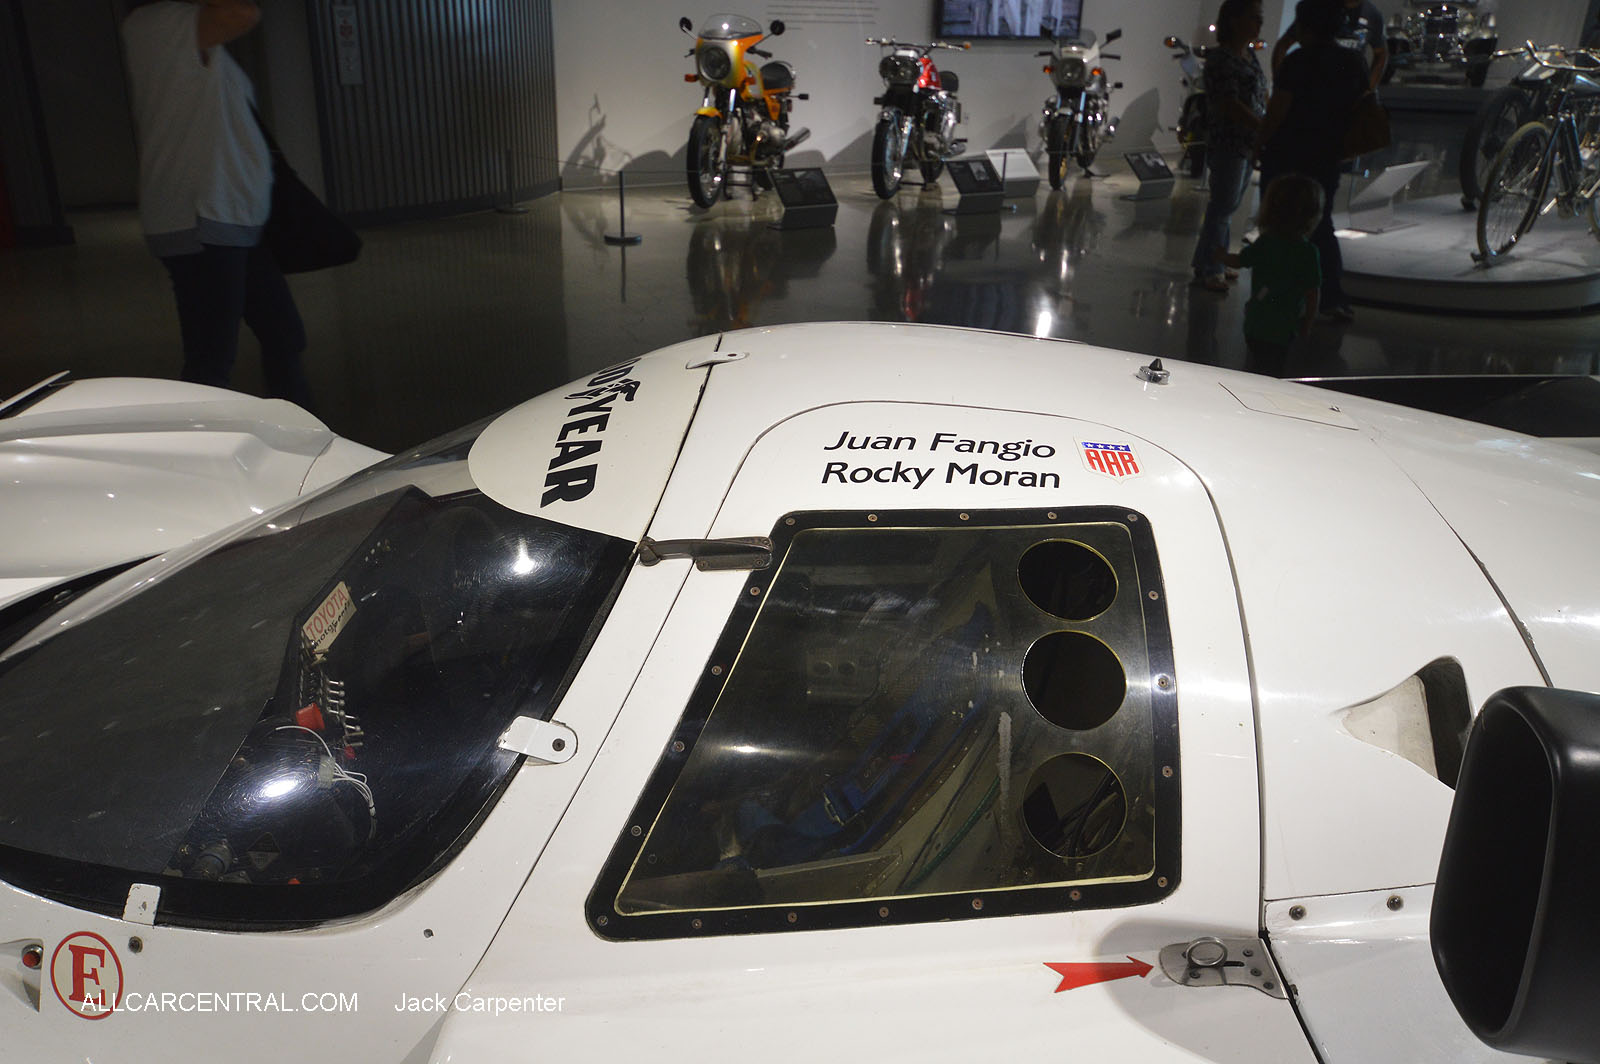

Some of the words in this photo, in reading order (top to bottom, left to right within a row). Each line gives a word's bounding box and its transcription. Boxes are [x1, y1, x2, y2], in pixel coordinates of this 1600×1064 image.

[823, 431, 917, 451] Juan
[929, 432, 1056, 462] Fangio
[821, 461, 935, 490] Rocky
[945, 461, 1061, 489] Moran
[1084, 448, 1140, 477] AAR
[305, 588, 348, 640] TOYOTA
[68, 943, 106, 1007] E
